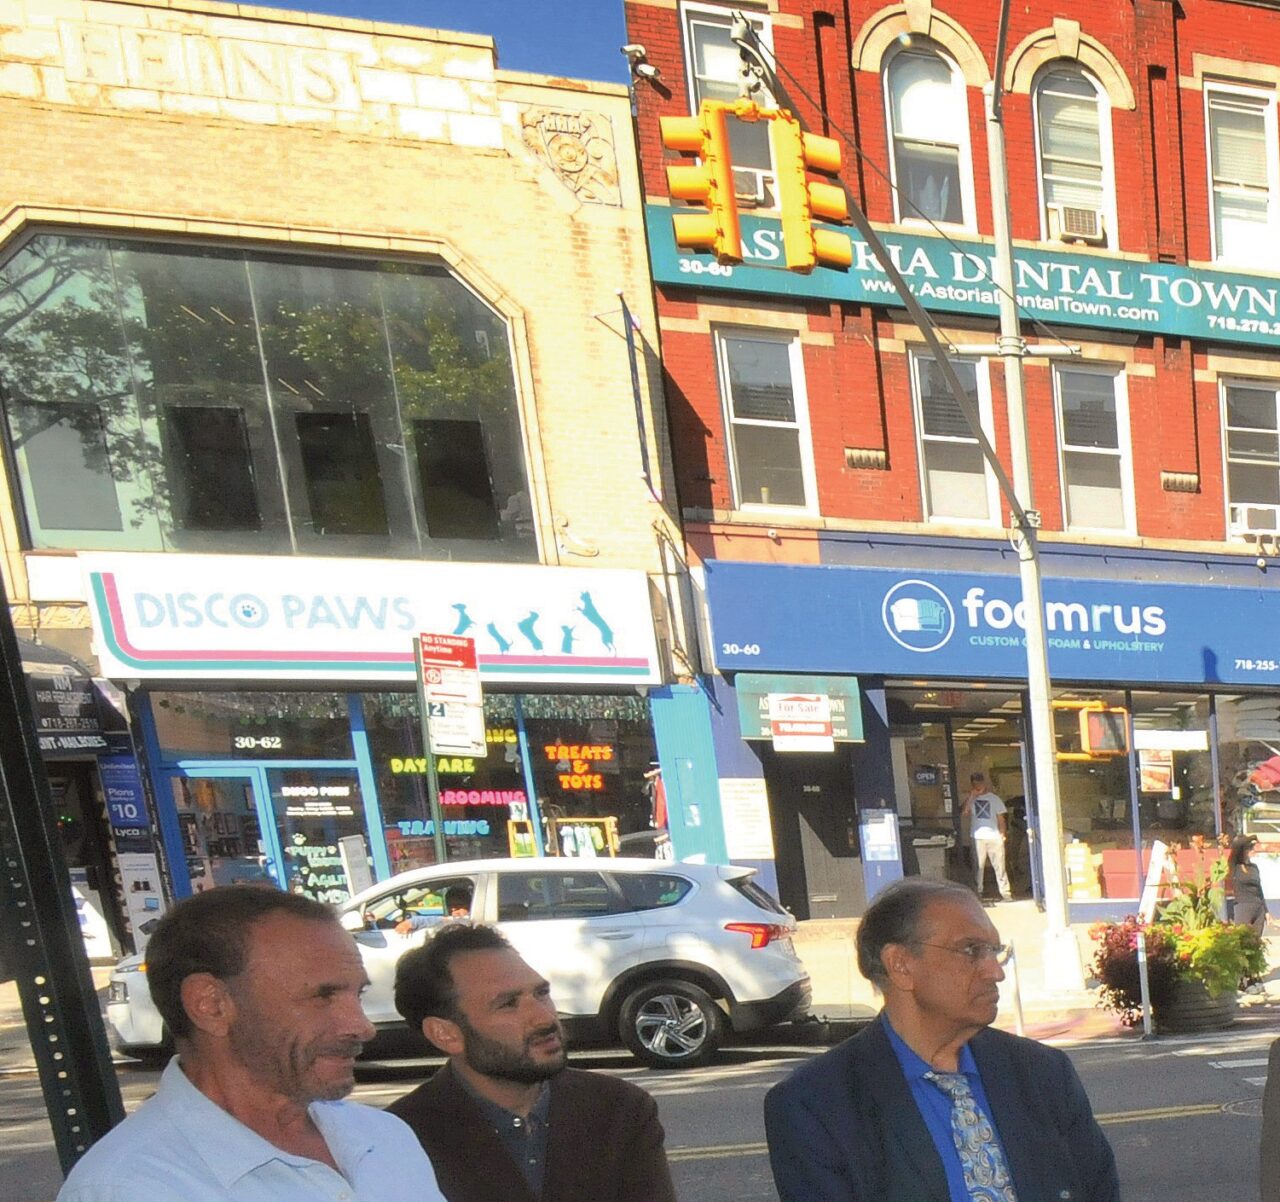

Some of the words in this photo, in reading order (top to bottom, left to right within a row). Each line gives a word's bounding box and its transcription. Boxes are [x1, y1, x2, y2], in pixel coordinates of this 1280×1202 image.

[1140, 272, 1278, 317] TOWN
[134, 592, 269, 630] DISCO
[281, 594, 416, 630] PAWS
[423, 644, 453, 654] Anytime
[434, 637, 468, 647] STANDING
[969, 635, 1020, 647] CUSTOM
[1048, 638, 1081, 650] FOAM
[1083, 639, 1091, 650] &
[1094, 640, 1165, 652] UPHOLSTERY
[722, 643, 760, 656] 30-60
[234, 736, 282, 749] 30-62
[545, 744, 613, 760] TREATS
[390, 758, 475, 773] DAYARE
[572, 760, 589, 774] &
[559, 774, 603, 789] TOYS
[916, 772, 936, 780] OPEN
[108, 788, 134, 796] Plans
[112, 803, 138, 819] $10
[115, 827, 140, 838] Lyca
